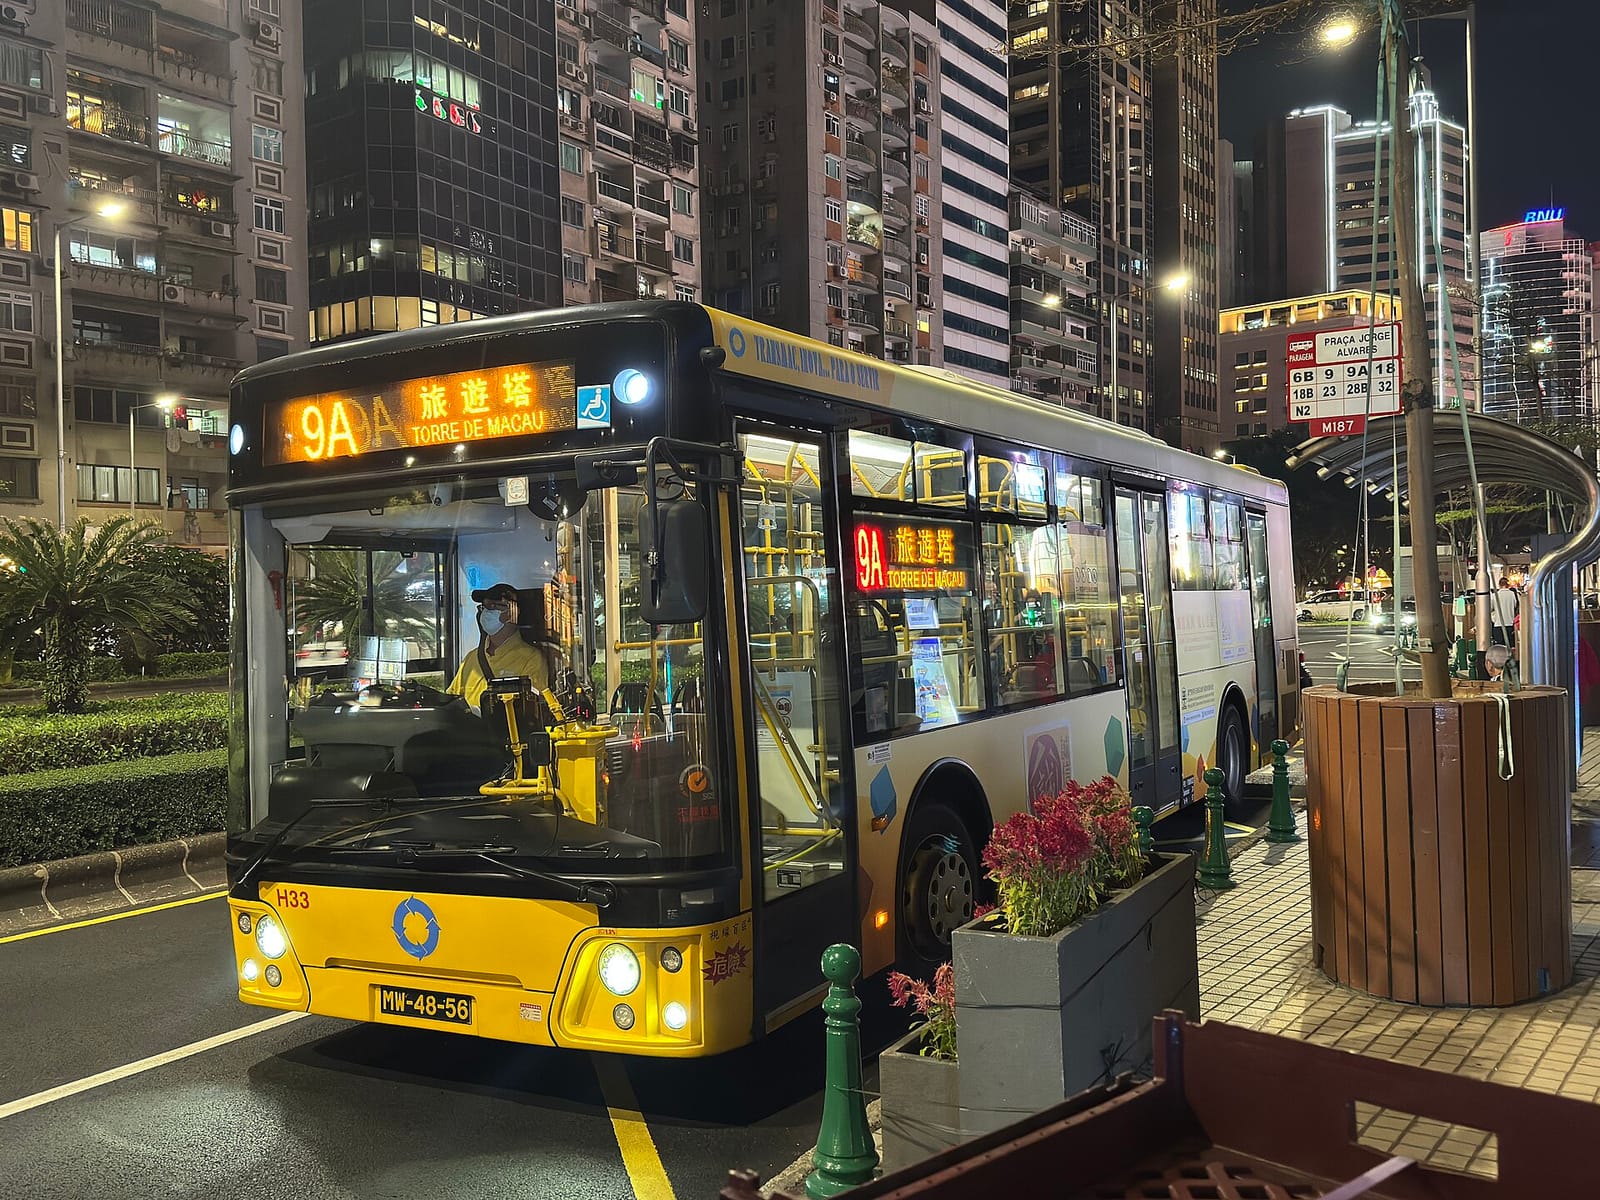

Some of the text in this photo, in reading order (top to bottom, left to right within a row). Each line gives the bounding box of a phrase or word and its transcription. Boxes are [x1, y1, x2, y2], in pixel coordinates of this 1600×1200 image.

[1324, 331, 1391, 347] PRAÇA JORGE
[1288, 353, 1314, 363] PARAGEM
[1336, 345, 1378, 357] ALVARES
[1293, 362, 1396, 382] 6B 9 9A 18
[420, 371, 532, 420] 旅遊塔
[1293, 381, 1392, 399] 18B 23 28B 32
[1296, 405, 1311, 416] N2
[301, 401, 359, 459] 9A
[411, 422, 460, 445] TORRE
[463, 418, 484, 438] DE
[487, 411, 545, 435] MACAU
[1322, 421, 1354, 433] M187
[896, 526, 953, 565] 旅遊塔
[858, 528, 883, 587] 9A
[888, 571, 966, 588] TORRE DE MACAU
[276, 888, 310, 909] H33
[382, 989, 469, 1020] MW-48-56
